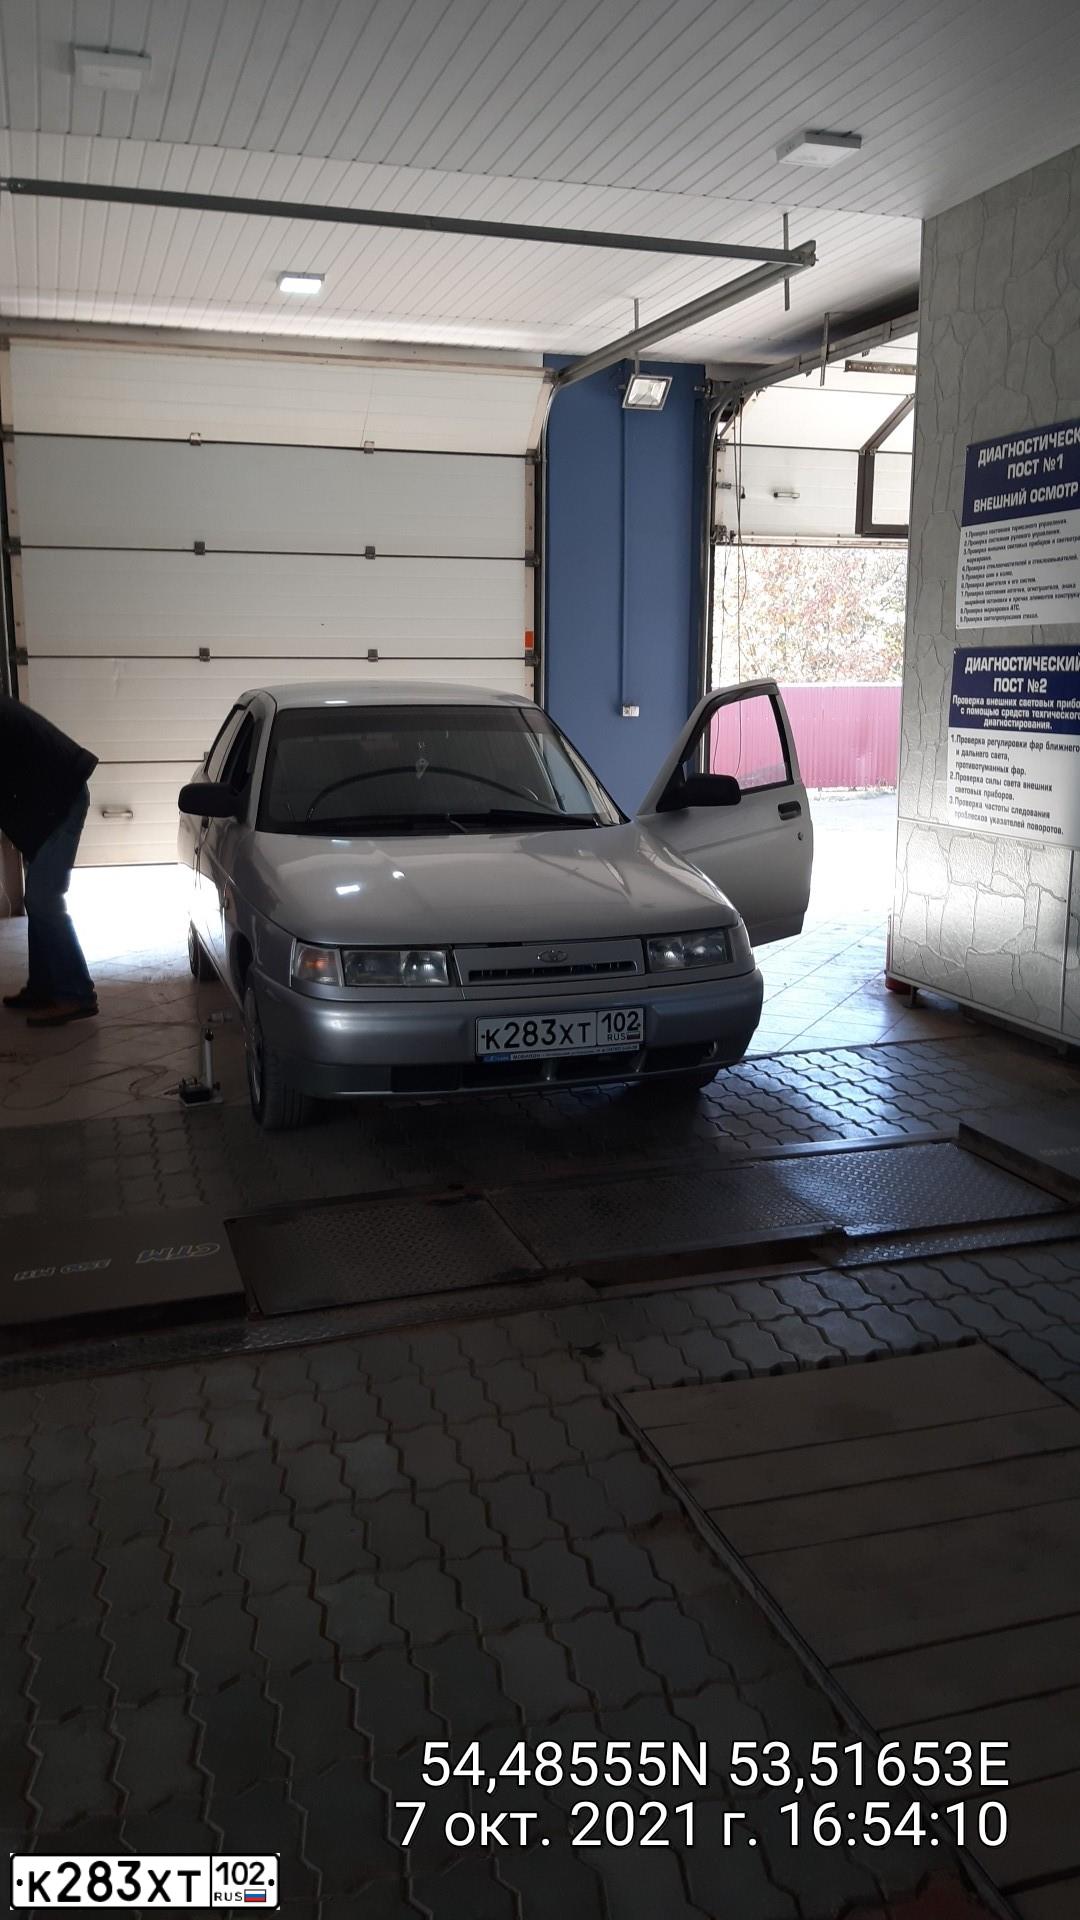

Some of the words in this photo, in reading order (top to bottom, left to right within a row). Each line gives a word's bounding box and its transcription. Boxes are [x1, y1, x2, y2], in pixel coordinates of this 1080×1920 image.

[978, 427, 1080, 468] ДИАГНОСТИЧЕСК
[1008, 459, 1039, 479] ПОСТ
[1043, 454, 1063, 472] №1
[974, 488, 1026, 513] ВНЕШНИЙ
[1030, 482, 1078, 503] ОСМОТР
[993, 678, 1024, 692] ПОСТ
[1027, 678, 1047, 693] №2
[952, 695, 984, 707] Проверка
[986, 698, 1016, 706] внешних
[1019, 698, 1054, 707] световых
[967, 707, 999, 716] помощью
[1001, 708, 1029, 718] средств
[984, 718, 1052, 730] диагностирования.
[987, 739, 1027, 749] регулировки
[1029, 740, 1043, 752] фар
[1046, 741, 1080, 753] ближнего
[961, 749, 988, 758] дальнего
[956, 761, 1009, 773] противотуманных
[955, 785, 981, 796] световых
[986, 777, 1001, 786] силы
[1004, 779, 1020, 788] света
[1023, 781, 1052, 792] внешних
[985, 802, 1009, 812] частоты
[1011, 806, 1050, 819] следования
[990, 816, 1024, 828] указателей
[601, 1011, 640, 1033] 102
[607, 1033, 626, 1042] RUS
